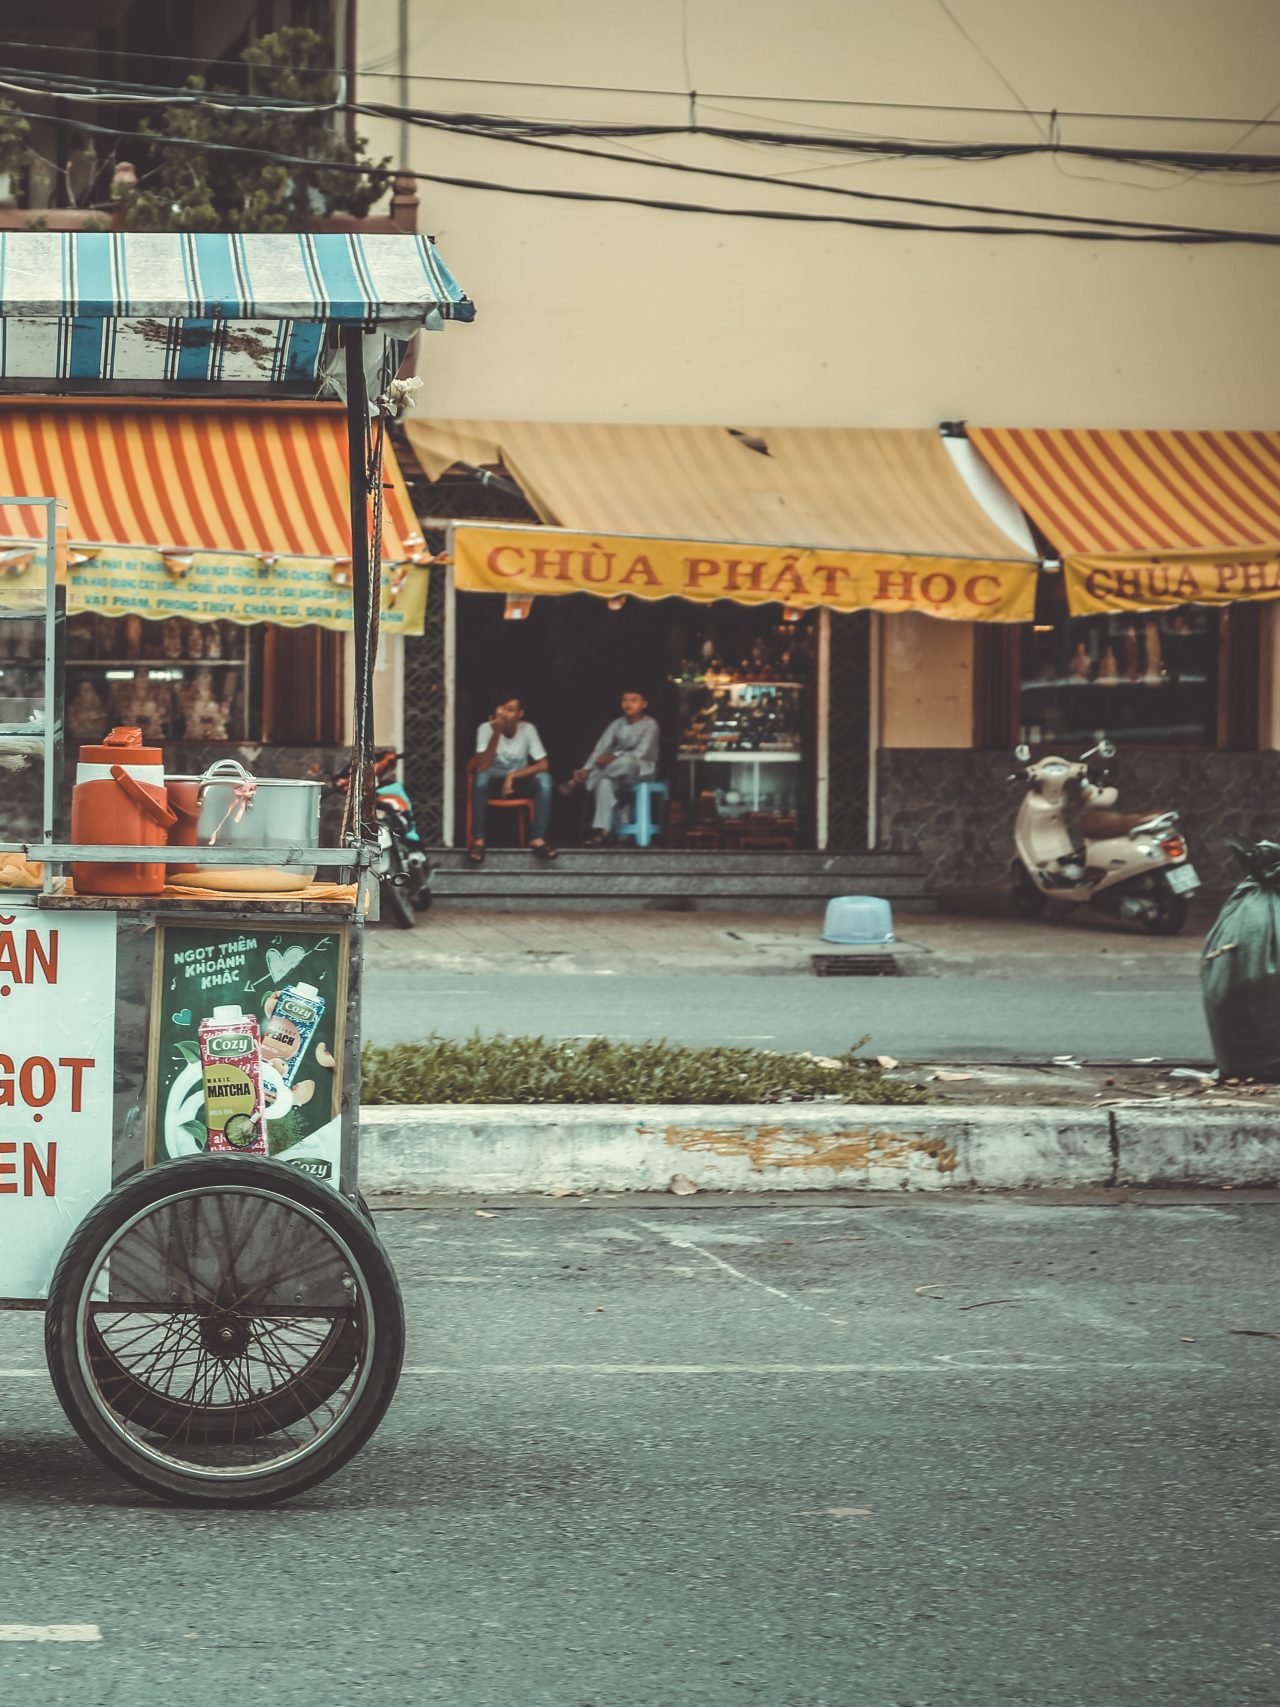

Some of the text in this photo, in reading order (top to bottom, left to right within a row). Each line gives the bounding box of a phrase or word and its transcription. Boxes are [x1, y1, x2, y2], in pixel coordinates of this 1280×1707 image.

[486, 541, 1005, 609] CHÙA PHẬT HỌC
[1084, 552, 1280, 600] CHÙA PH
[174, 935, 258, 965] NGỌT THÊM
[284, 1001, 313, 1020] Cozy
[211, 1037, 249, 1052] Cozy
[206, 1076, 231, 1084] MAGIC
[207, 1083, 251, 1099] MATCHA
